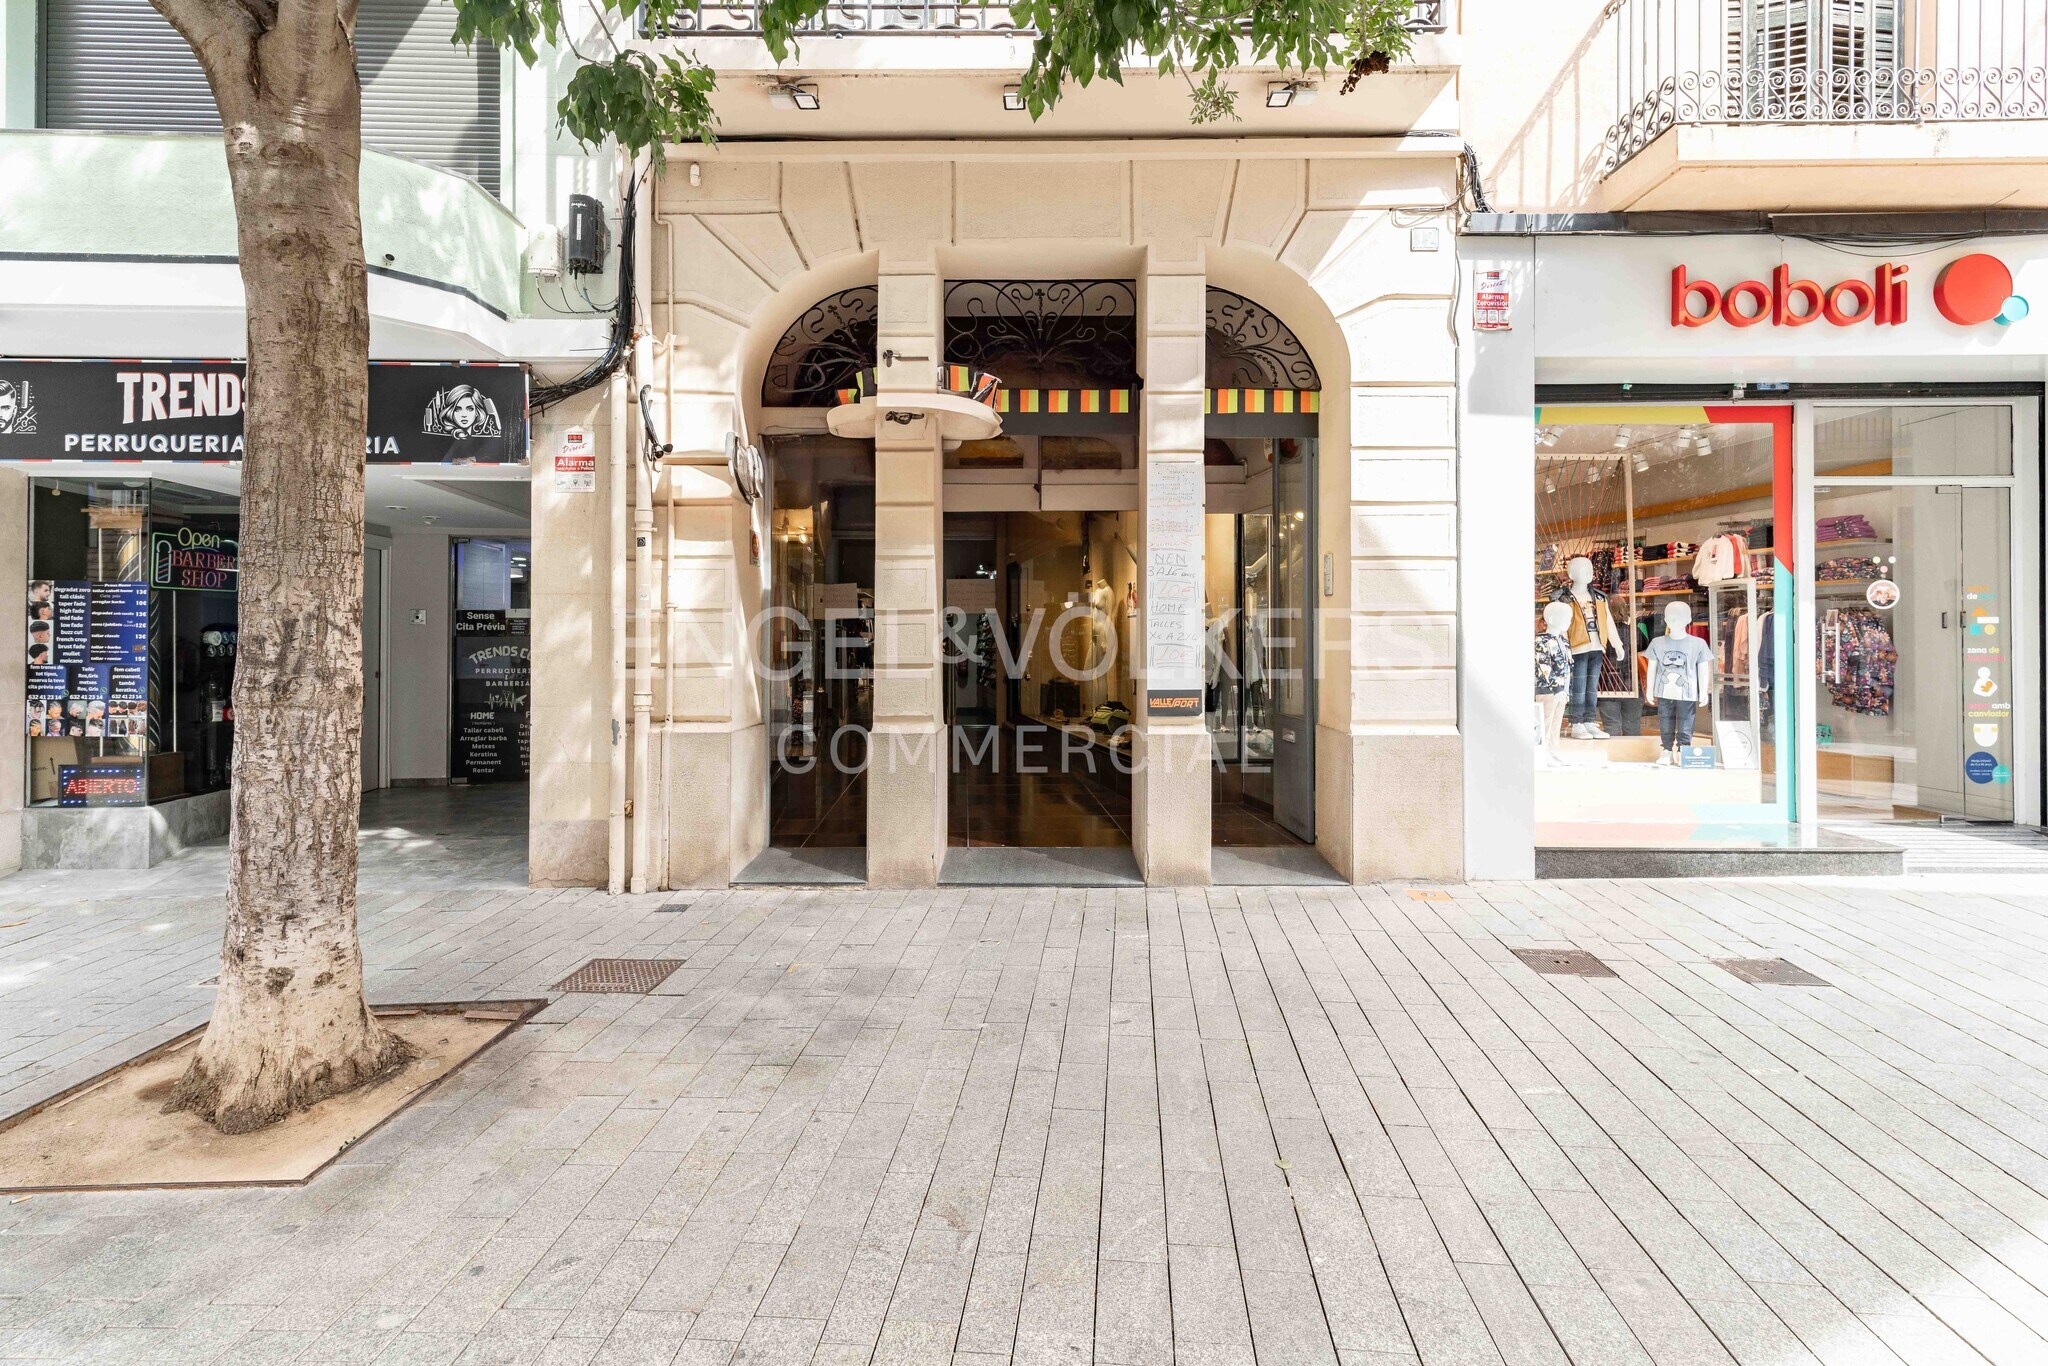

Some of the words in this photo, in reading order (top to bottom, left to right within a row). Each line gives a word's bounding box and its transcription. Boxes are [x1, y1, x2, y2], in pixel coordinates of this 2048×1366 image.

[1671, 262, 1909, 327] boboli
[116, 372, 248, 424] TREND
[64, 433, 245, 454] PERRUQUERIA
[556, 458, 594, 466] Alarma
[177, 527, 220, 550] Open
[172, 549, 236, 570] BARBER
[1155, 554, 1186, 564] NEN
[181, 569, 228, 588] SHOP
[1148, 566, 1154, 576] 3
[1152, 602, 1185, 612] HOME
[476, 622, 505, 630] Prévia
[1148, 619, 1182, 628] TALLES
[469, 646, 518, 664] TRENDS
[66, 778, 136, 794] ABIERTO
